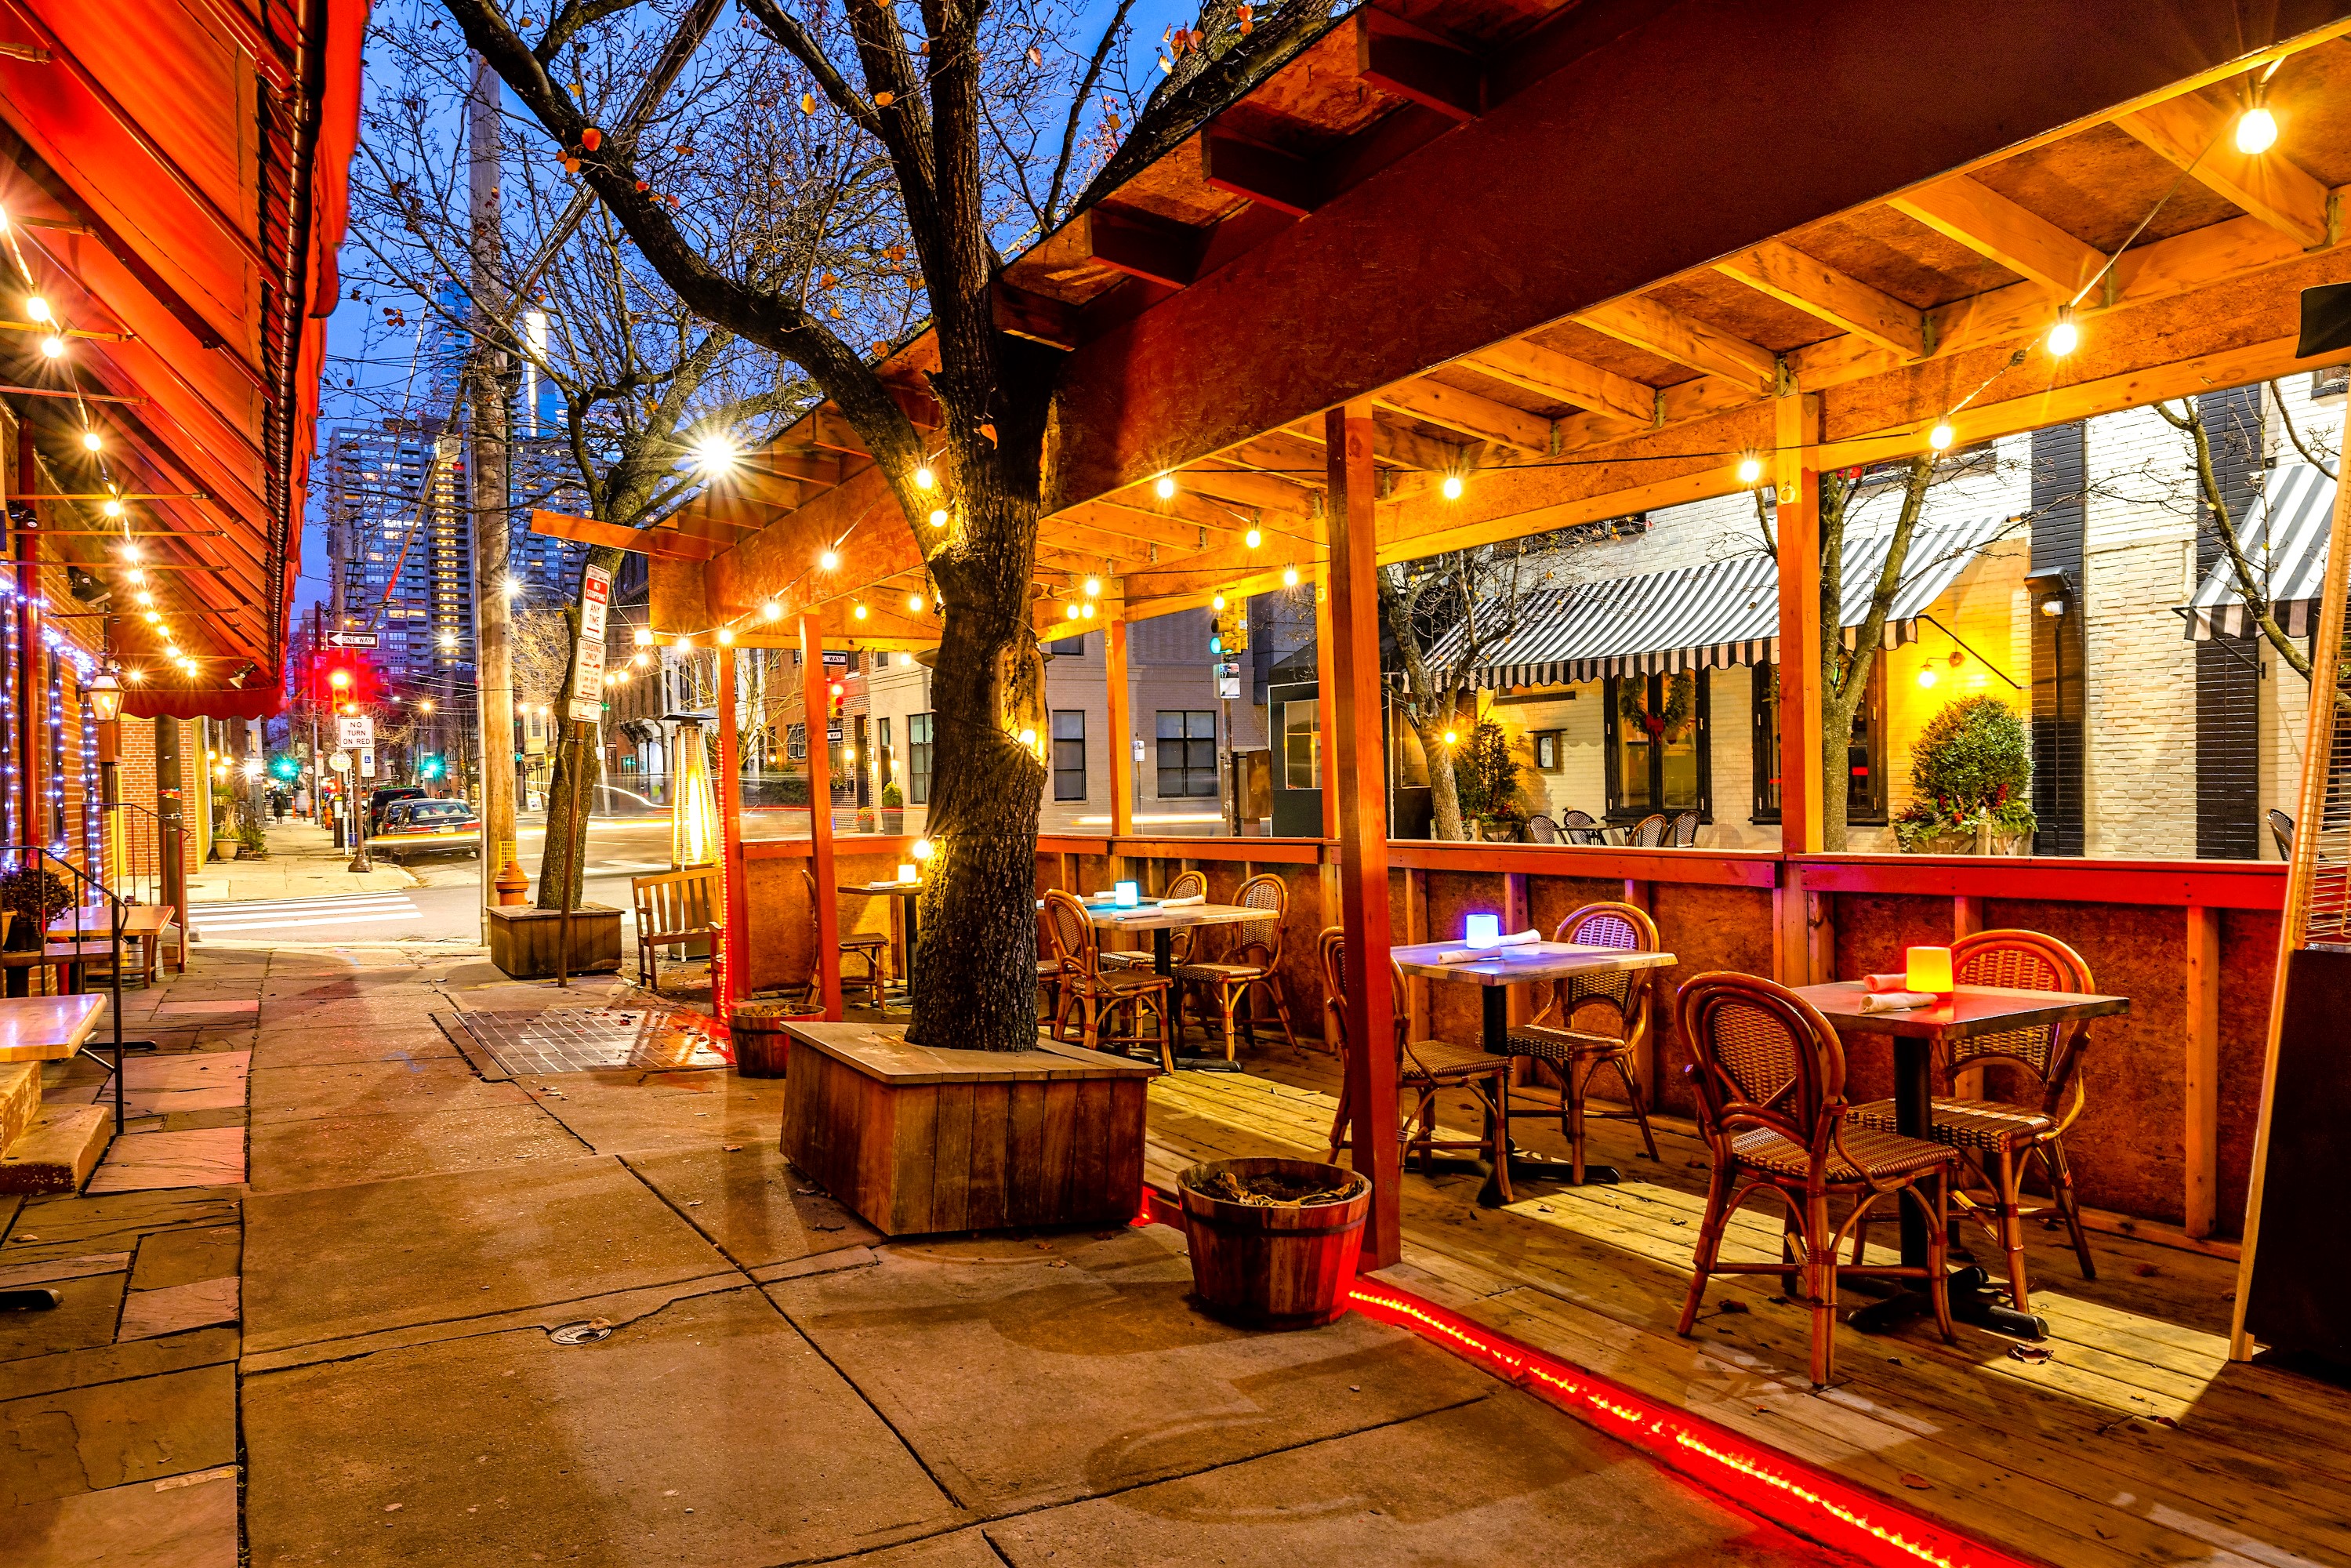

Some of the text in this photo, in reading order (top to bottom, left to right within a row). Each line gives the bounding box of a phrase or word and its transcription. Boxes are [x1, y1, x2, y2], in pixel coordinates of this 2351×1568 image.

[593, 582, 600, 590] NO
[586, 590, 606, 602] STOPPING
[590, 604, 600, 615] ANY
[589, 615, 600, 626] TIME
[582, 642, 601, 653] LOADING
[586, 652, 597, 661] ONLY
